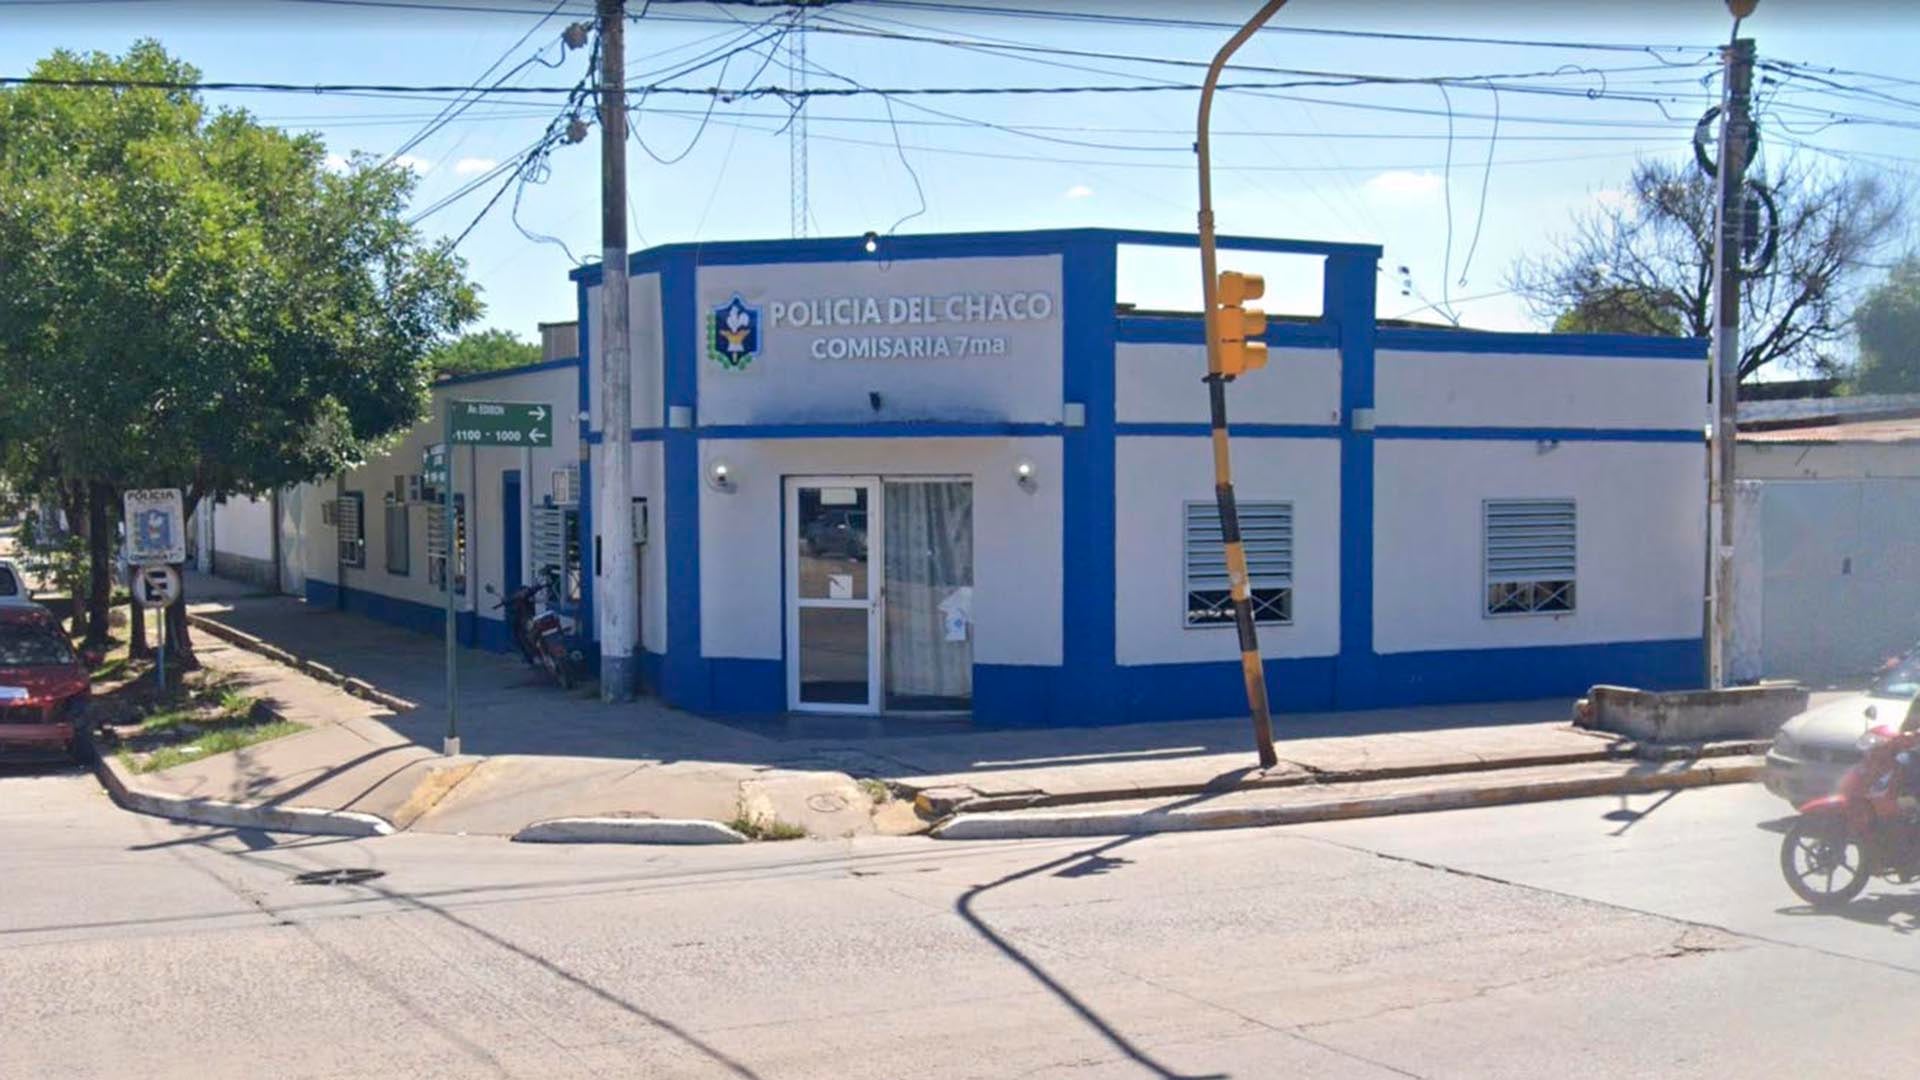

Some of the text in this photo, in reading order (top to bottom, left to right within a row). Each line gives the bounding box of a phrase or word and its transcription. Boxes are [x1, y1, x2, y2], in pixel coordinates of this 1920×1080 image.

[769, 293, 1053, 328] POLICIA DEL CHACO
[811, 335, 1006, 360] COMISARIA 7ma
[455, 429, 482, 441] 1100
[495, 430, 522, 442] 1000
